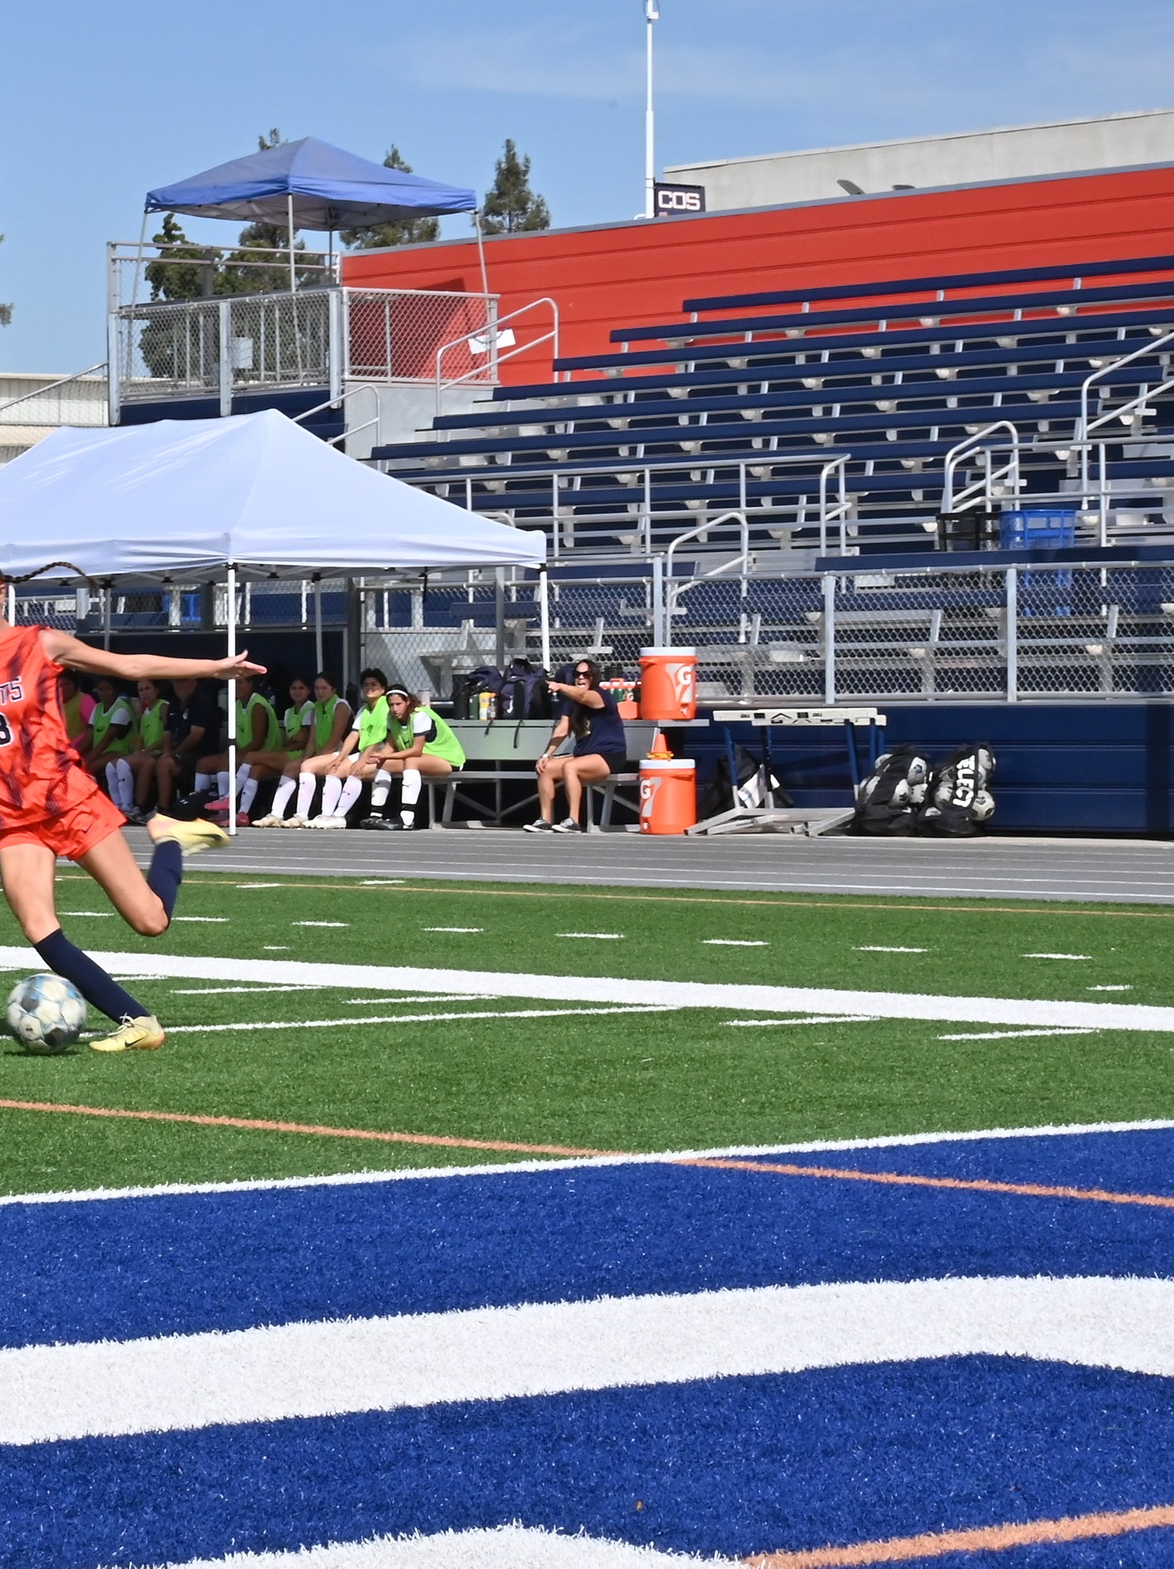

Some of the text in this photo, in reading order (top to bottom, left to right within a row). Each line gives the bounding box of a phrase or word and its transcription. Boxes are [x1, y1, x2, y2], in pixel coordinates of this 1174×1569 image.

[658, 190, 701, 211] COS
[677, 665, 692, 686] G
[639, 779, 652, 799] G
[952, 754, 976, 808] ELECT
